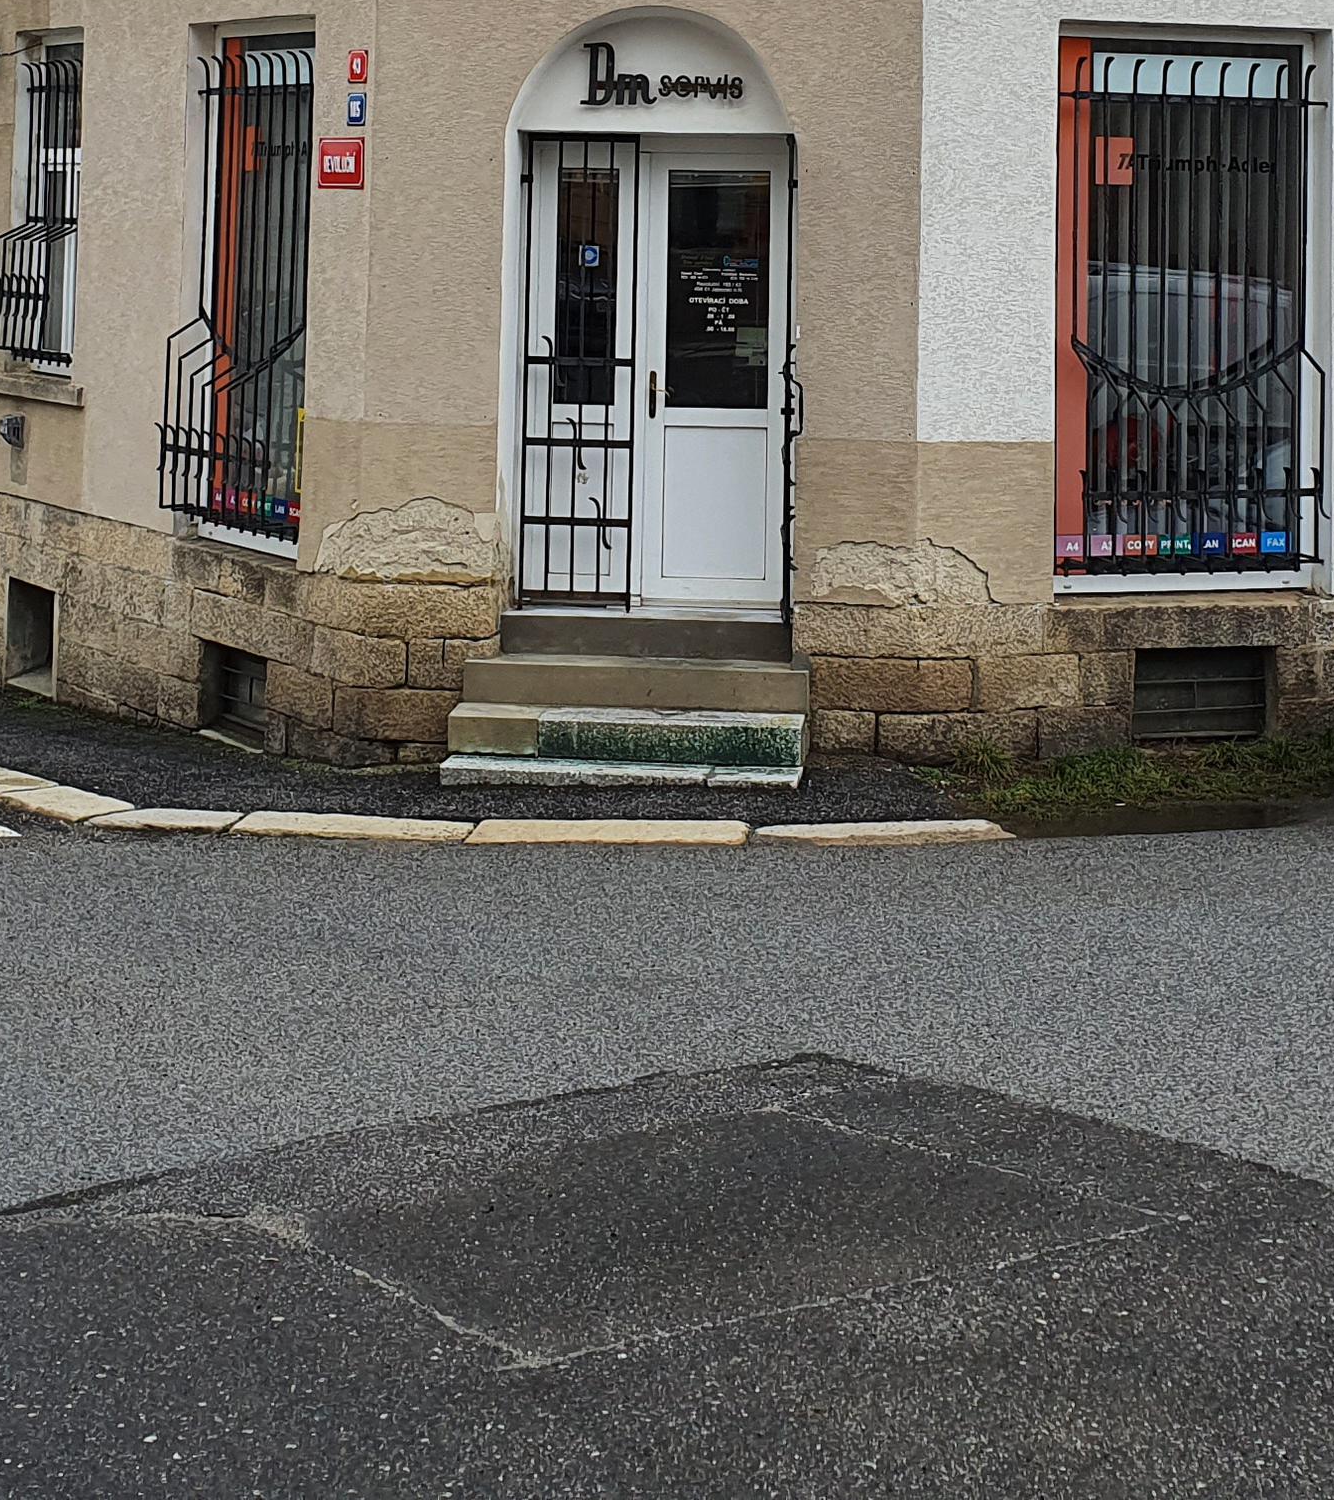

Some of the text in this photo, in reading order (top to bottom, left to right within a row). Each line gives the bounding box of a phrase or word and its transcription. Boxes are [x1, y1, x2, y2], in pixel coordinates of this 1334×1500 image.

[579, 41, 658, 106] Dm
[1066, 541, 1079, 551] A4
[1267, 537, 1285, 547] FAX
